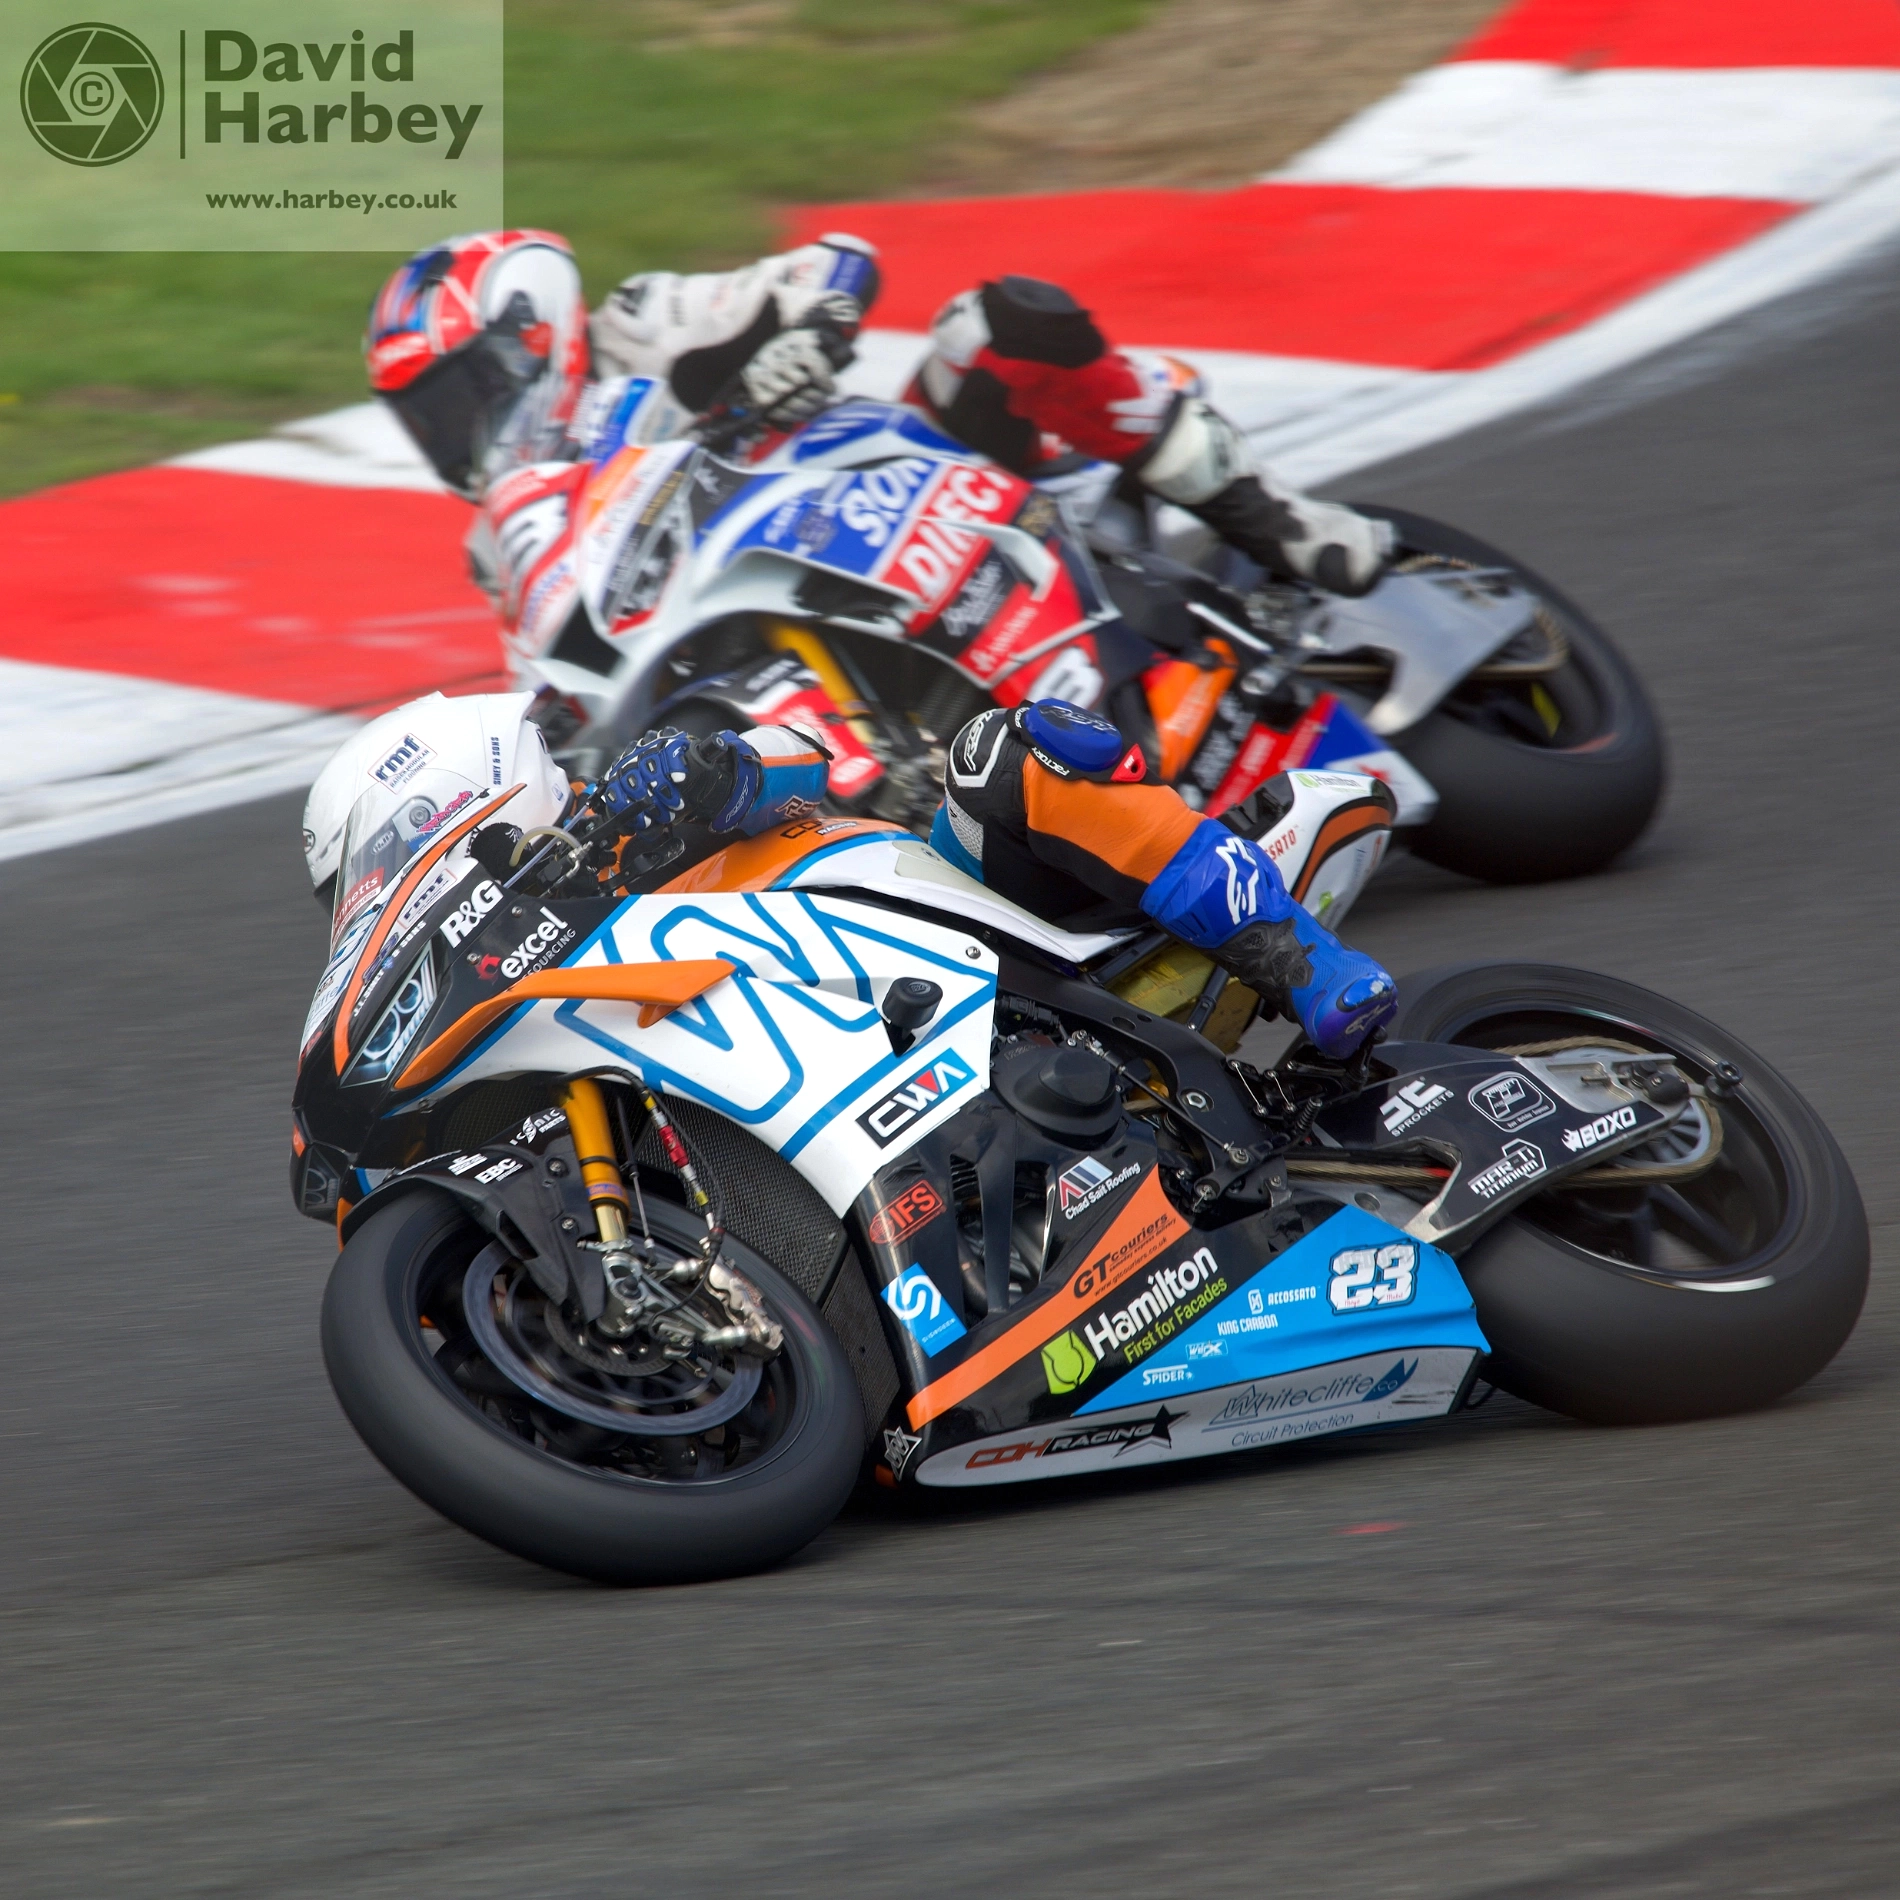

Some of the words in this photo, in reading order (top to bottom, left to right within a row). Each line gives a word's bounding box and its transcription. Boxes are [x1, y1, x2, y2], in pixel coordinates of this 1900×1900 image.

[375, 734, 420, 781] rmf
[403, 873, 446, 920] rmf
[440, 879, 504, 948] R&G
[400, 920, 427, 949] SONS
[501, 906, 568, 979] excel
[868, 1061, 967, 1137] CWA
[1391, 1090, 1454, 1137] SPROCKETS
[1580, 1106, 1637, 1149] BOXO
[474, 1158, 517, 1184] EBC
[1065, 1197, 1090, 1220] Chad
[1105, 1162, 1141, 1191] Roofing
[888, 1186, 936, 1229] IFS
[1074, 1251, 1111, 1299] GT
[1110, 1213, 1168, 1262] couriers
[1329, 1243, 1415, 1312] 23
[1083, 1246, 1219, 1360] Hamilton
[1268, 1286, 1317, 1306] ACCOSSATO
[1123, 1336, 1158, 1364] First
[1155, 1315, 1176, 1342] for
[1174, 1277, 1228, 1325] Facades
[1217, 1319, 1239, 1336] KING
[1240, 1313, 1278, 1332] CARBON
[1143, 1364, 1188, 1386] SPIDER
[1052, 1427, 1154, 1452] RACING
[1231, 1427, 1279, 1447] Circuit
[1281, 1412, 1354, 1440] Protection
